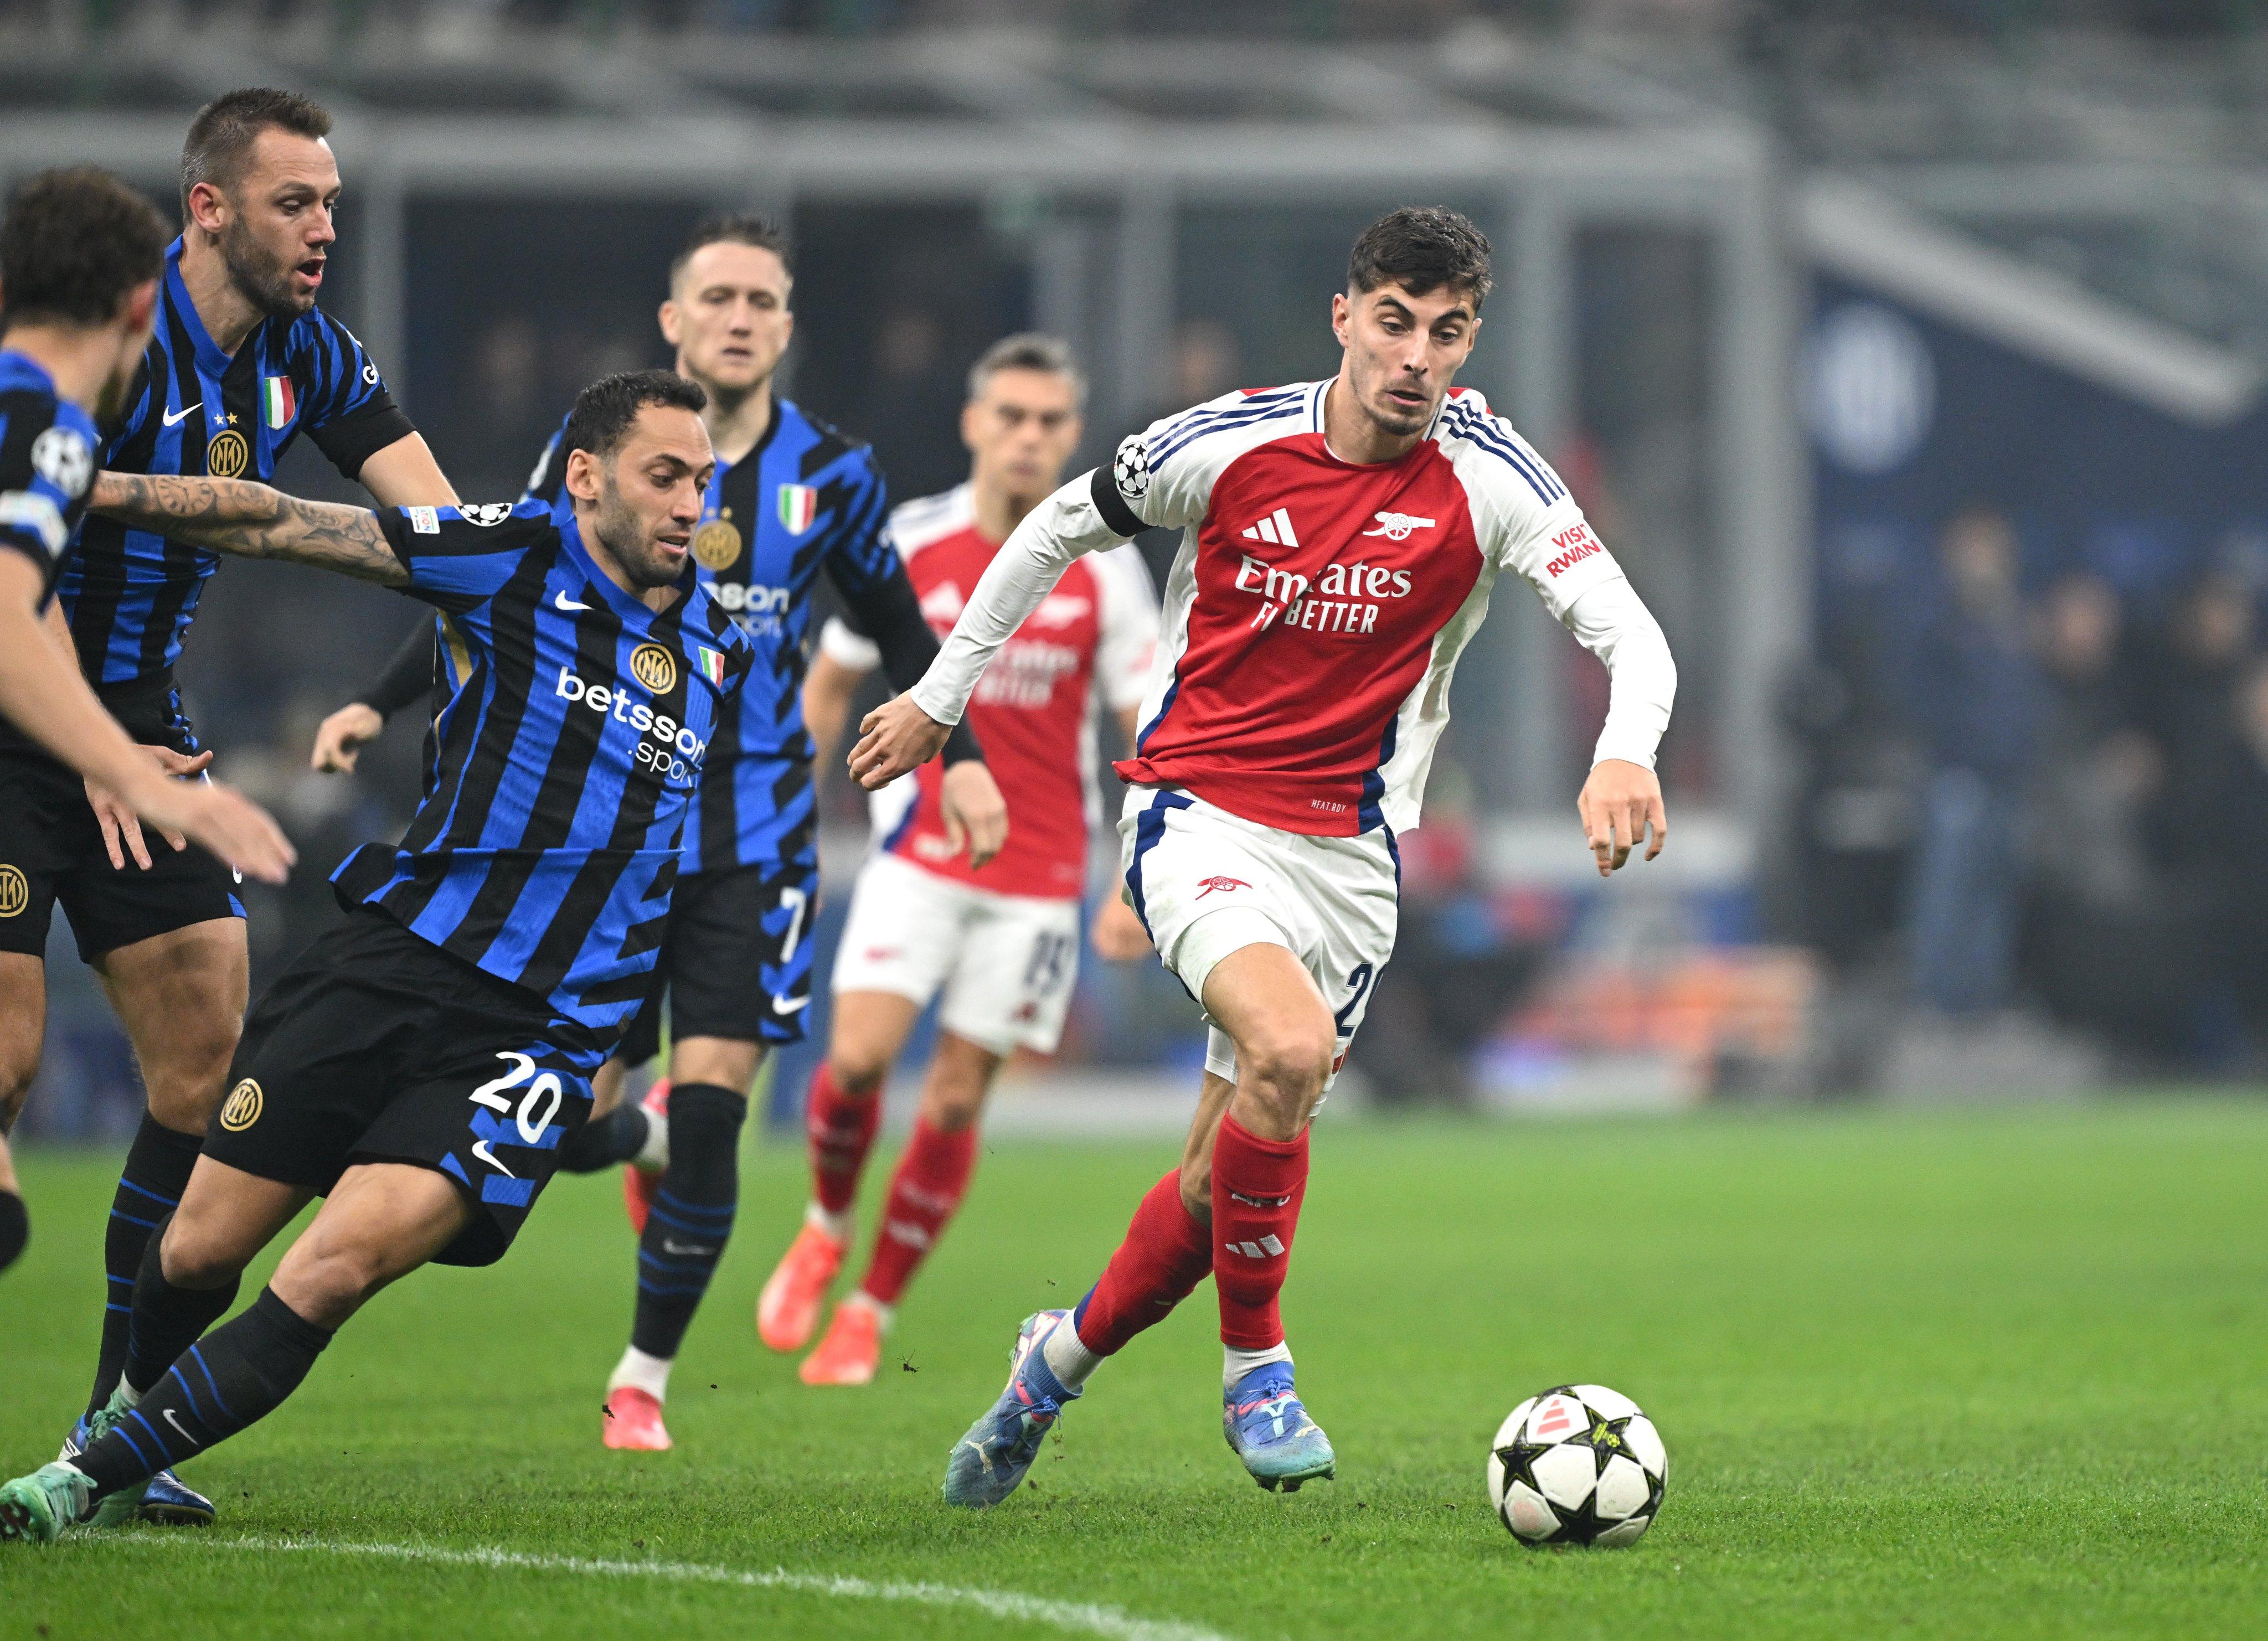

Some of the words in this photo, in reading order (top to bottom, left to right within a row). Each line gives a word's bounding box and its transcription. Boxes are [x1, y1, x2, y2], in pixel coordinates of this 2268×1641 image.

[1551, 523, 1586, 549] VISI
[1235, 554, 1411, 605] Emates
[1546, 539, 1601, 579] RWAN
[1284, 598, 1379, 633] BETTER
[555, 665, 706, 762] betsson
[1311, 799, 1347, 813] HEAT.RDY
[780, 887, 806, 964] 7
[468, 1051, 562, 1144] 20
